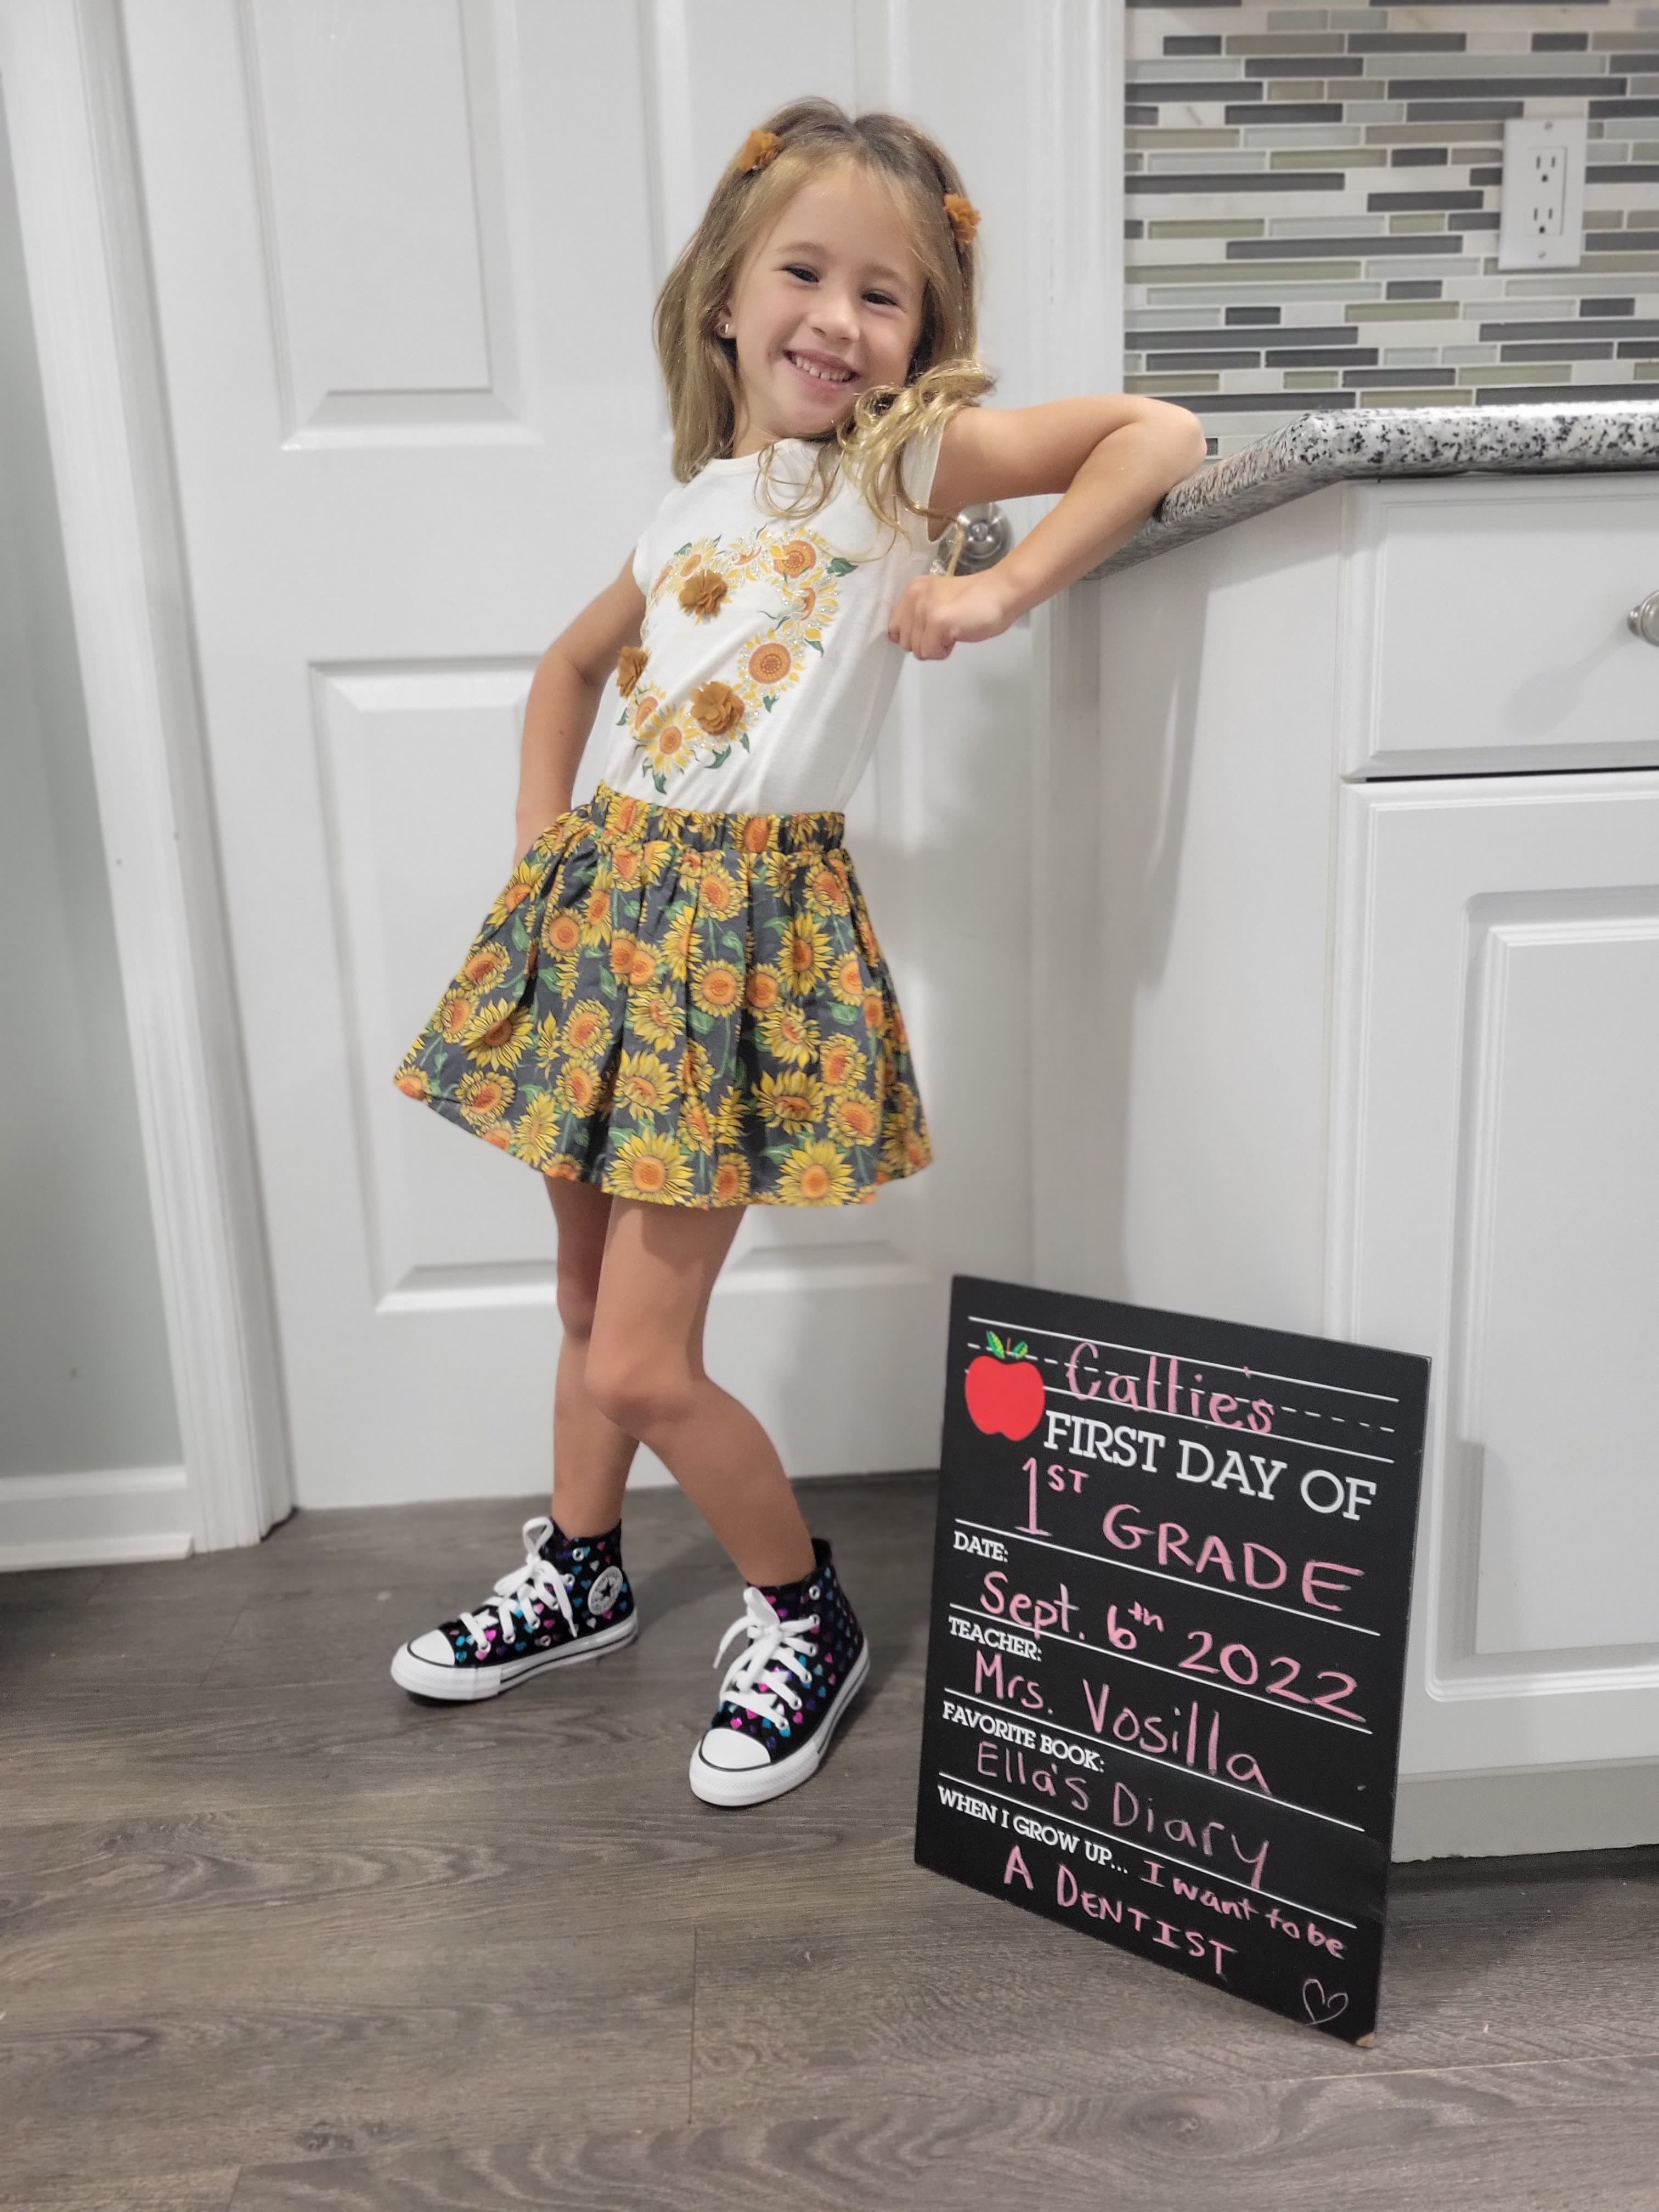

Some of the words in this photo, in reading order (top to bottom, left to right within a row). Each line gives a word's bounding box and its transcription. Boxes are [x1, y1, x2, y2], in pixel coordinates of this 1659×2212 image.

[1043, 1410, 1166, 1473] FIRST
[1176, 1438, 1288, 1502] DAY
[1300, 1469, 1377, 1521] OF
[953, 1531, 1009, 1562] DATE:
[1014, 1457, 1090, 1537] 1ST
[1102, 1503, 1365, 1612] GRADE
[949, 1616, 1042, 1662] TEACHER:
[979, 1571, 1085, 1641] Sept.
[1107, 1600, 1165, 1651] 6th
[1178, 1631, 1367, 1723] 2022
[942, 1700, 1036, 1750] FAVORITE
[1040, 1733, 1104, 1773] BOOK:
[974, 1650, 1054, 1716] Mrs.
[1082, 1678, 1272, 1796] Vosilla
[938, 1786, 999, 1825] WHEN
[999, 1809, 1011, 1829] I
[1013, 1816, 1079, 1854] GROW
[977, 1740, 1089, 1811] Ella's
[1112, 1782, 1269, 1890] Diary
[1003, 1844, 1034, 1891] A
[1057, 1864, 1237, 1979] DENTIST
[1139, 1859, 1166, 1888] I
[1172, 1876, 1259, 1921] want
[1265, 1907, 1300, 1937] to
[1307, 1922, 1346, 1959] be
